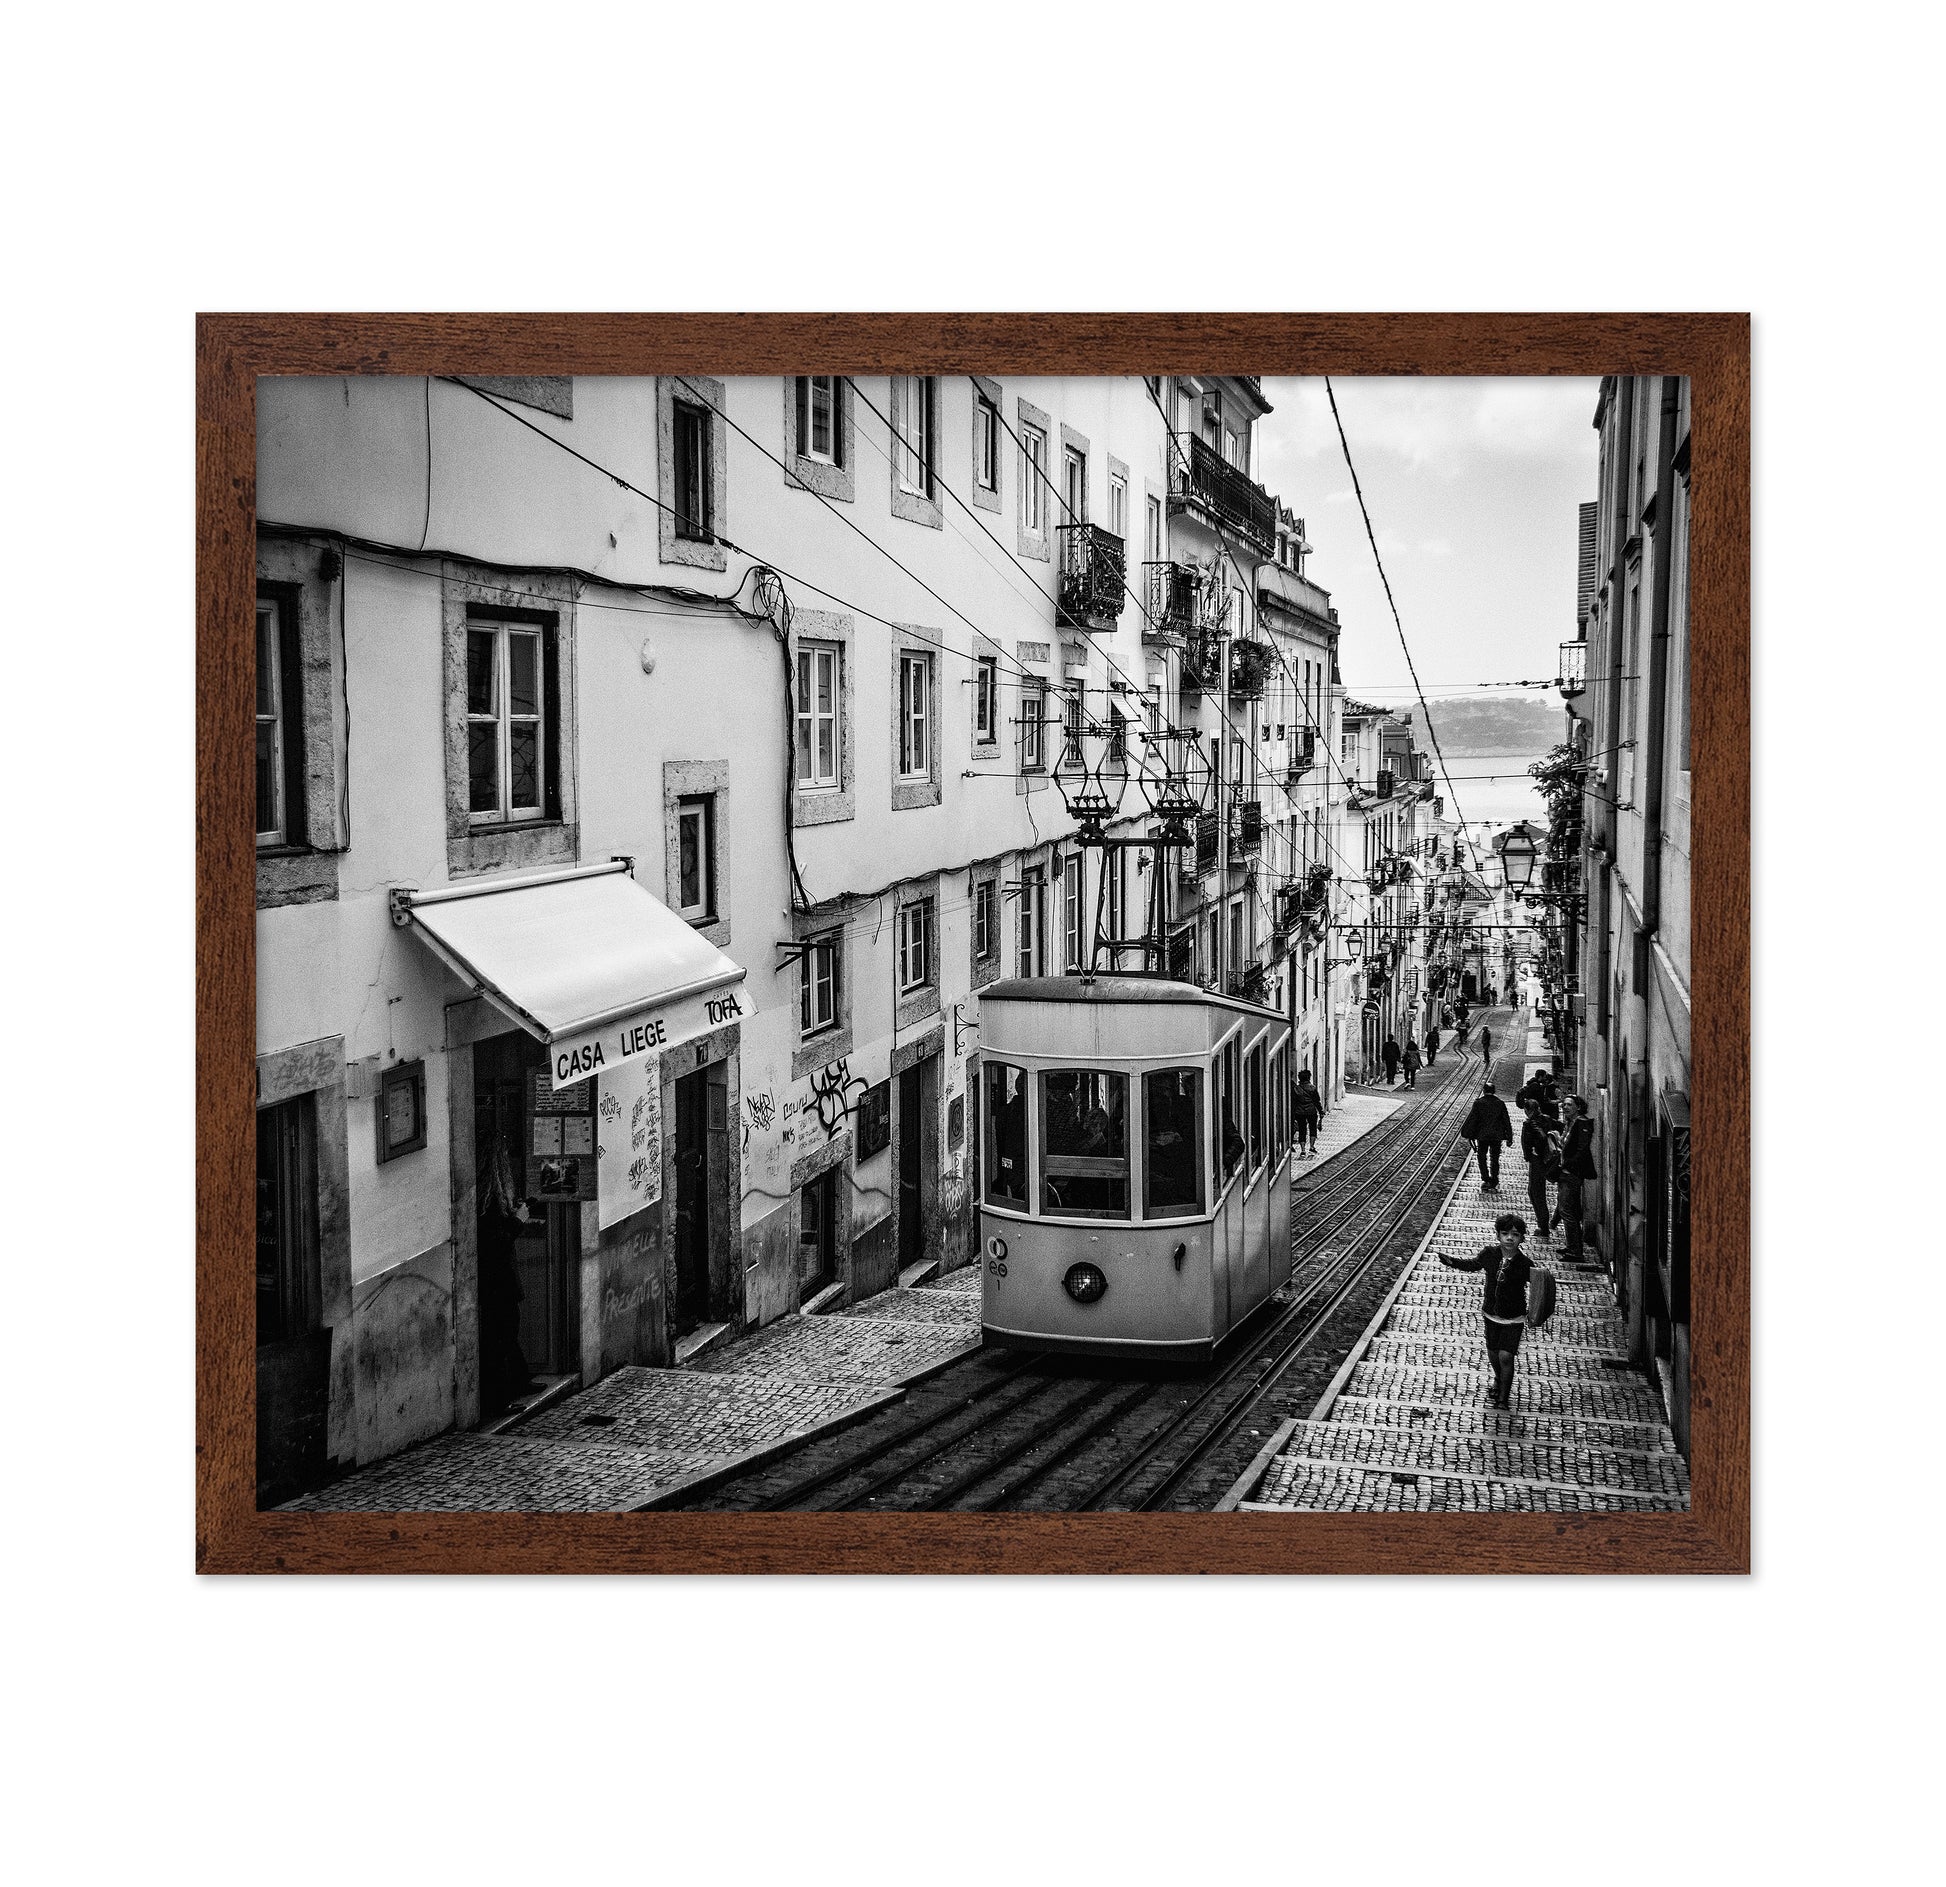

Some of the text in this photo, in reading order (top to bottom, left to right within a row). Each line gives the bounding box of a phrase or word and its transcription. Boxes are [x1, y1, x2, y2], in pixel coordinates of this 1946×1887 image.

[704, 993, 743, 1025] TOFA
[557, 1019, 667, 1080] CASA LIEGE
